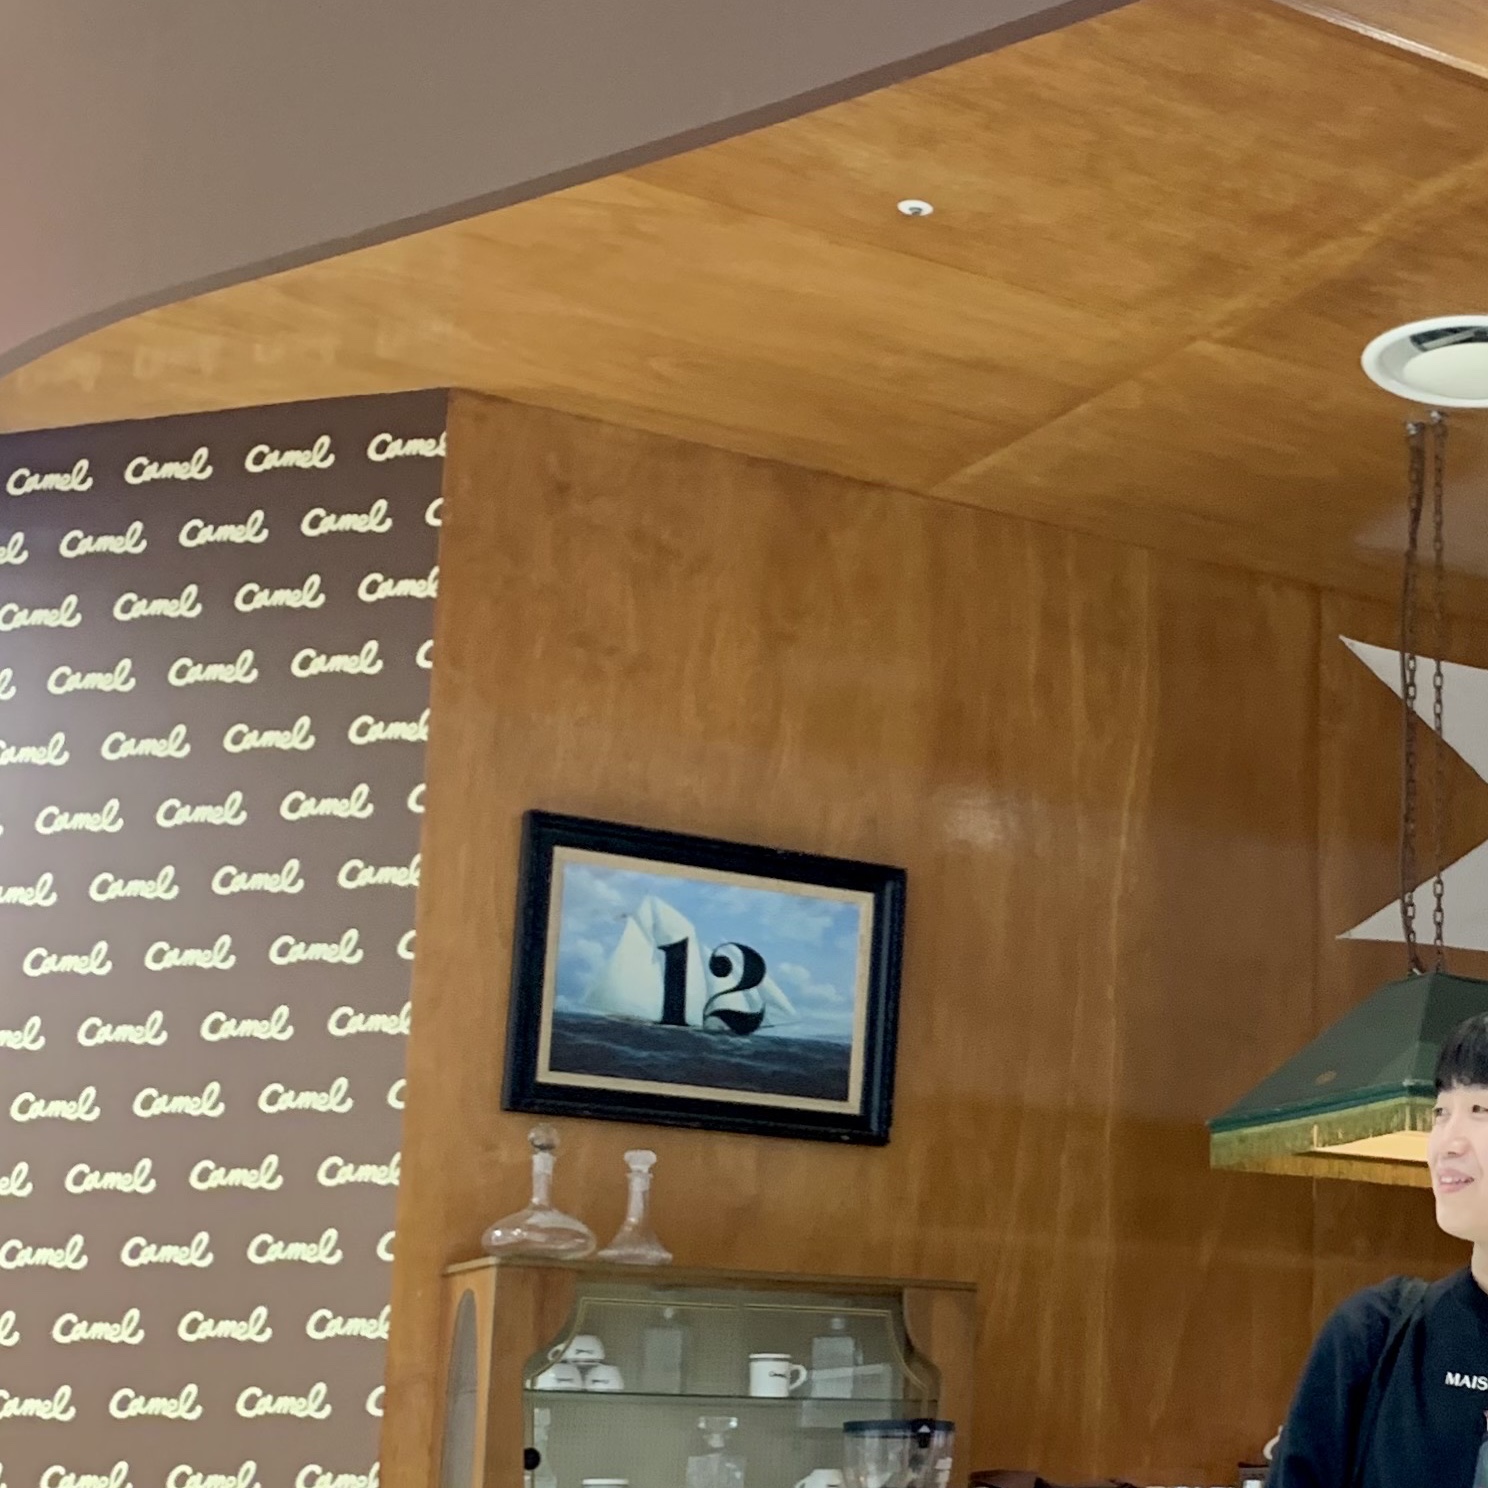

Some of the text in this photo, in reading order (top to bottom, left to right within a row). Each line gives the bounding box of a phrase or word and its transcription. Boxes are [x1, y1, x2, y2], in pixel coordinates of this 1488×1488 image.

[6, 459, 93, 495] Camel
[124, 447, 213, 484] Camel
[245, 435, 335, 472] Camel
[59, 521, 147, 558] Camel
[179, 510, 269, 547] Camel
[301, 499, 393, 536] Camel
[0, 595, 82, 631] Camel
[113, 584, 202, 621] Camel
[234, 574, 325, 612] Camel
[47, 658, 136, 694] Camel
[168, 649, 258, 686] Camel
[291, 640, 383, 677] Camel
[101, 724, 190, 760] Camel
[223, 716, 315, 753] Camel
[35, 799, 124, 834] Camel
[156, 791, 247, 827] Camel
[280, 783, 374, 820] Camel
[89, 865, 179, 901] Camel
[212, 859, 304, 895] Camel
[23, 941, 112, 976] Camel
[145, 935, 236, 971] Camel
[269, 929, 363, 965] Camel
[657, 936, 766, 1035] 12
[77, 1010, 168, 1046] Camel
[200, 1005, 294, 1041] Camel
[10, 1086, 100, 1121] Camel
[133, 1082, 225, 1117] Camel
[258, 1077, 353, 1113] Camel
[65, 1158, 156, 1194] Camel
[189, 1154, 283, 1190] Camel
[0, 1234, 88, 1270] Camel
[121, 1231, 213, 1267] Camel
[247, 1228, 342, 1265] Camel
[52, 1308, 145, 1344] Camel
[178, 1306, 272, 1342] Camel
[109, 1384, 202, 1420] Camel
[236, 1382, 332, 1419] Camel
